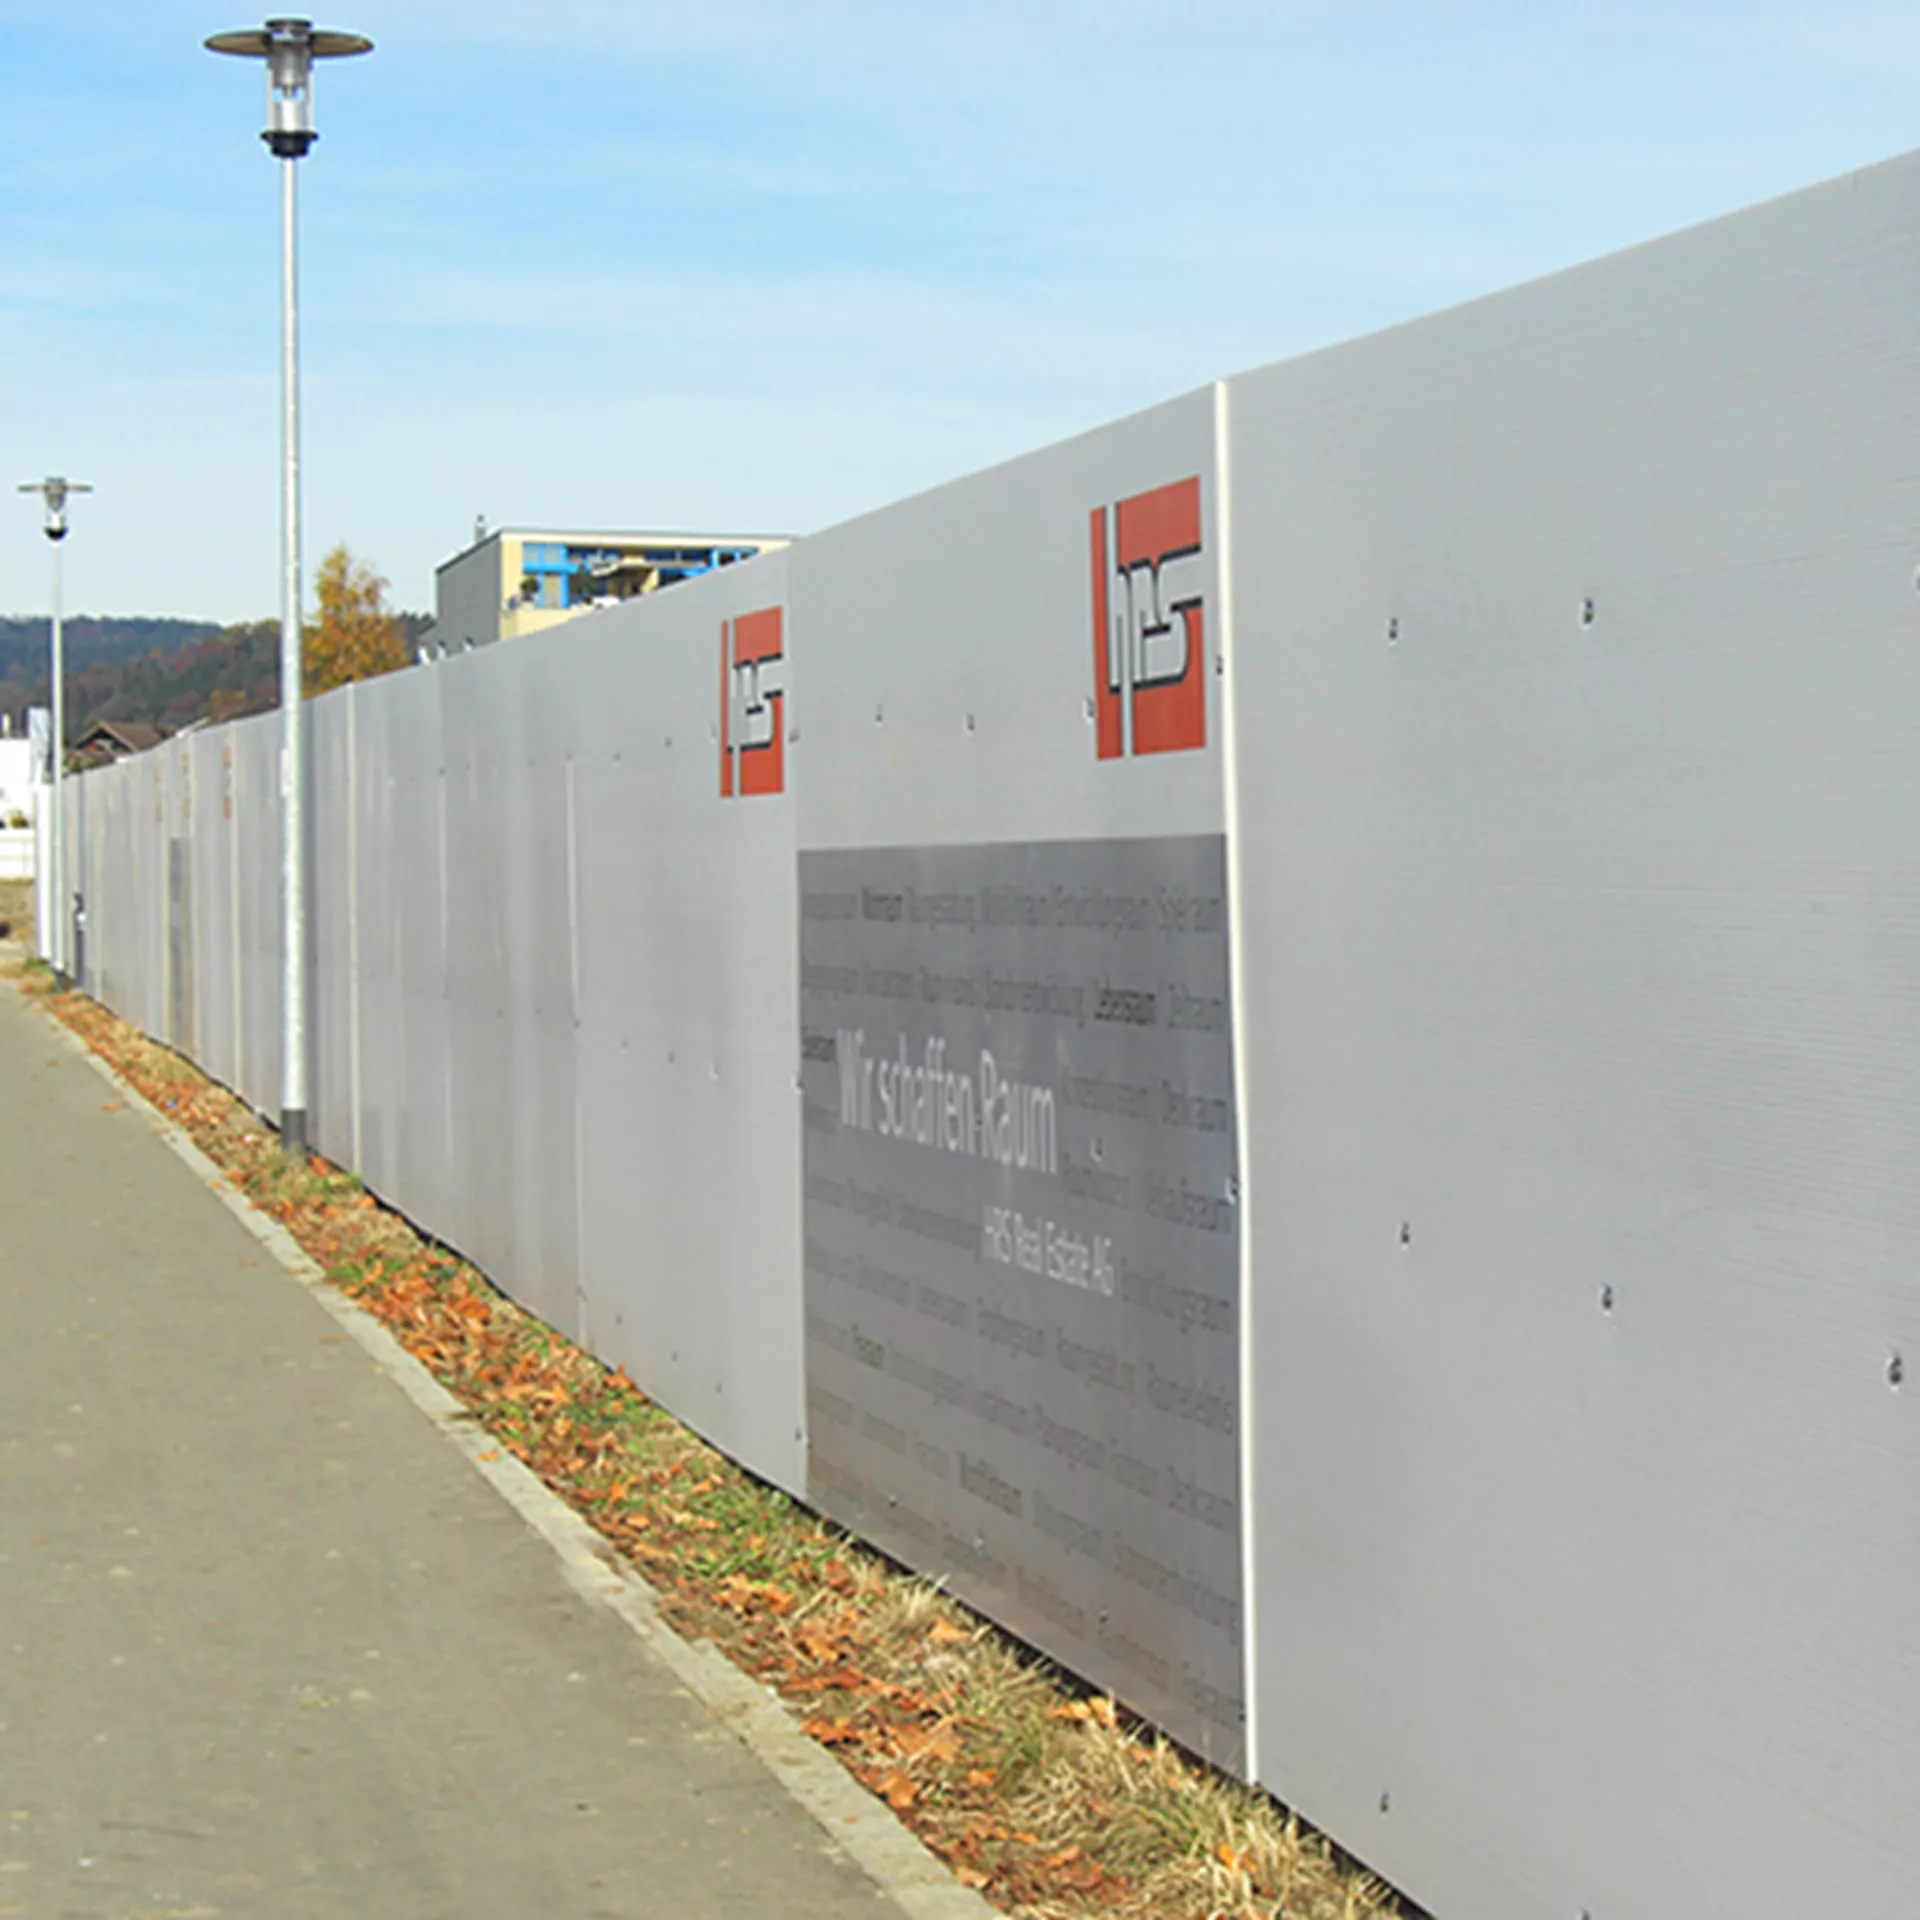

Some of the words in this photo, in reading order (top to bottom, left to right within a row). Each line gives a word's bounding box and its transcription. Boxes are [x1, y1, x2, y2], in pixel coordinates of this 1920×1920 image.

[836, 1027, 874, 1131] Wir
[877, 1031, 975, 1155] schaffen
[979, 1048, 1058, 1174] Raum
[1014, 1211, 1043, 1274] Real
[1045, 1220, 1090, 1289] Estate
